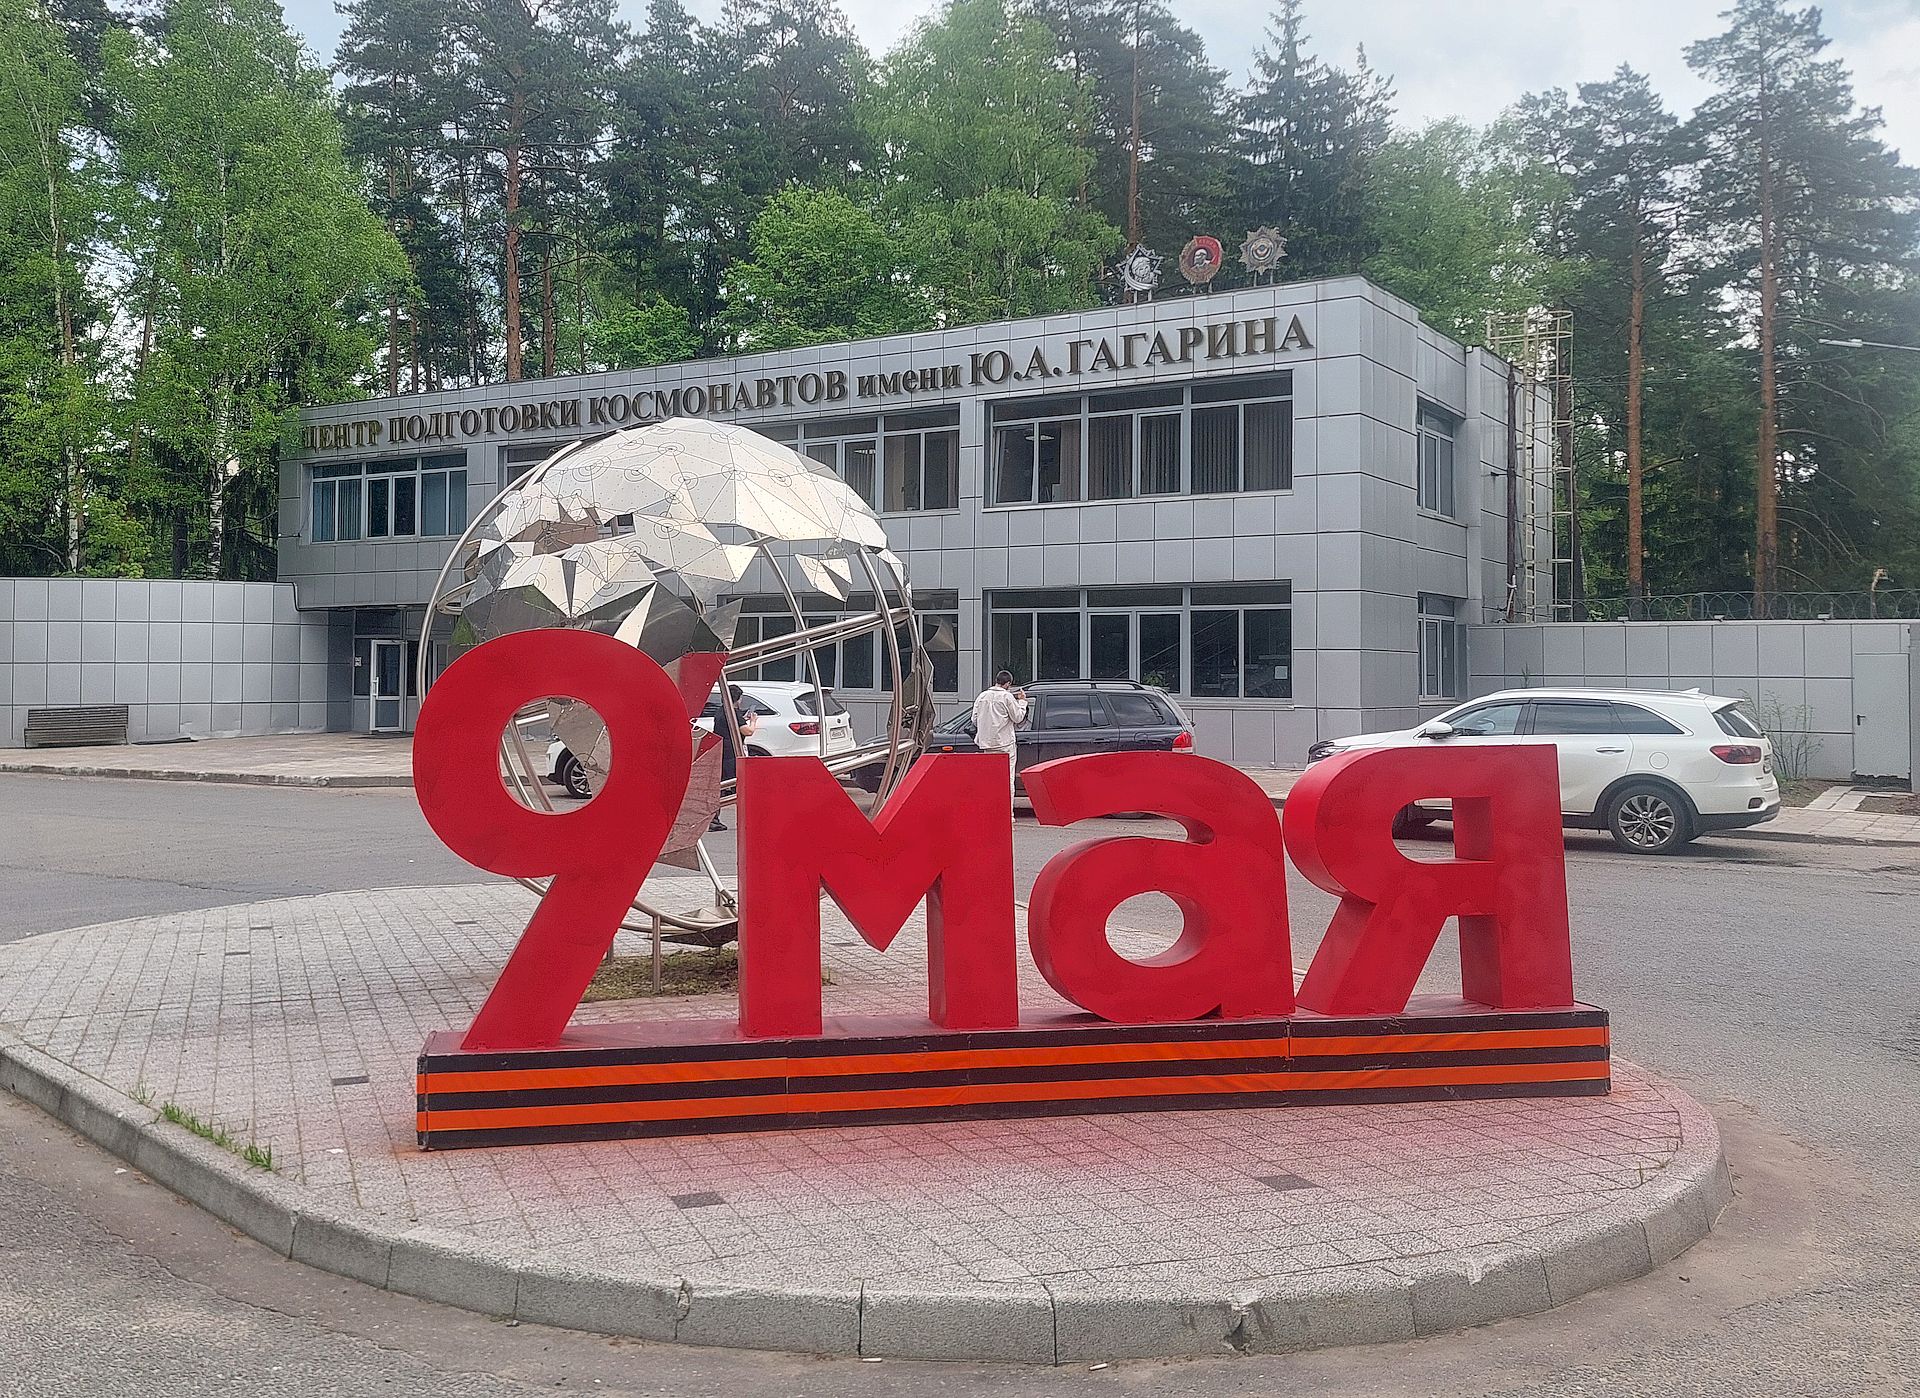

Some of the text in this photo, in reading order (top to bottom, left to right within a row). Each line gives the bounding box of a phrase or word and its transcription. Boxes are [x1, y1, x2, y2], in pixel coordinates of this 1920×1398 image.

[302, 420, 382, 453] ЦЕНТР
[388, 398, 582, 443] ПОДГОТОВКИ
[587, 370, 848, 425] КОСМОНАВТОВ
[857, 364, 962, 397] имени
[412, 628, 692, 1049] 9
